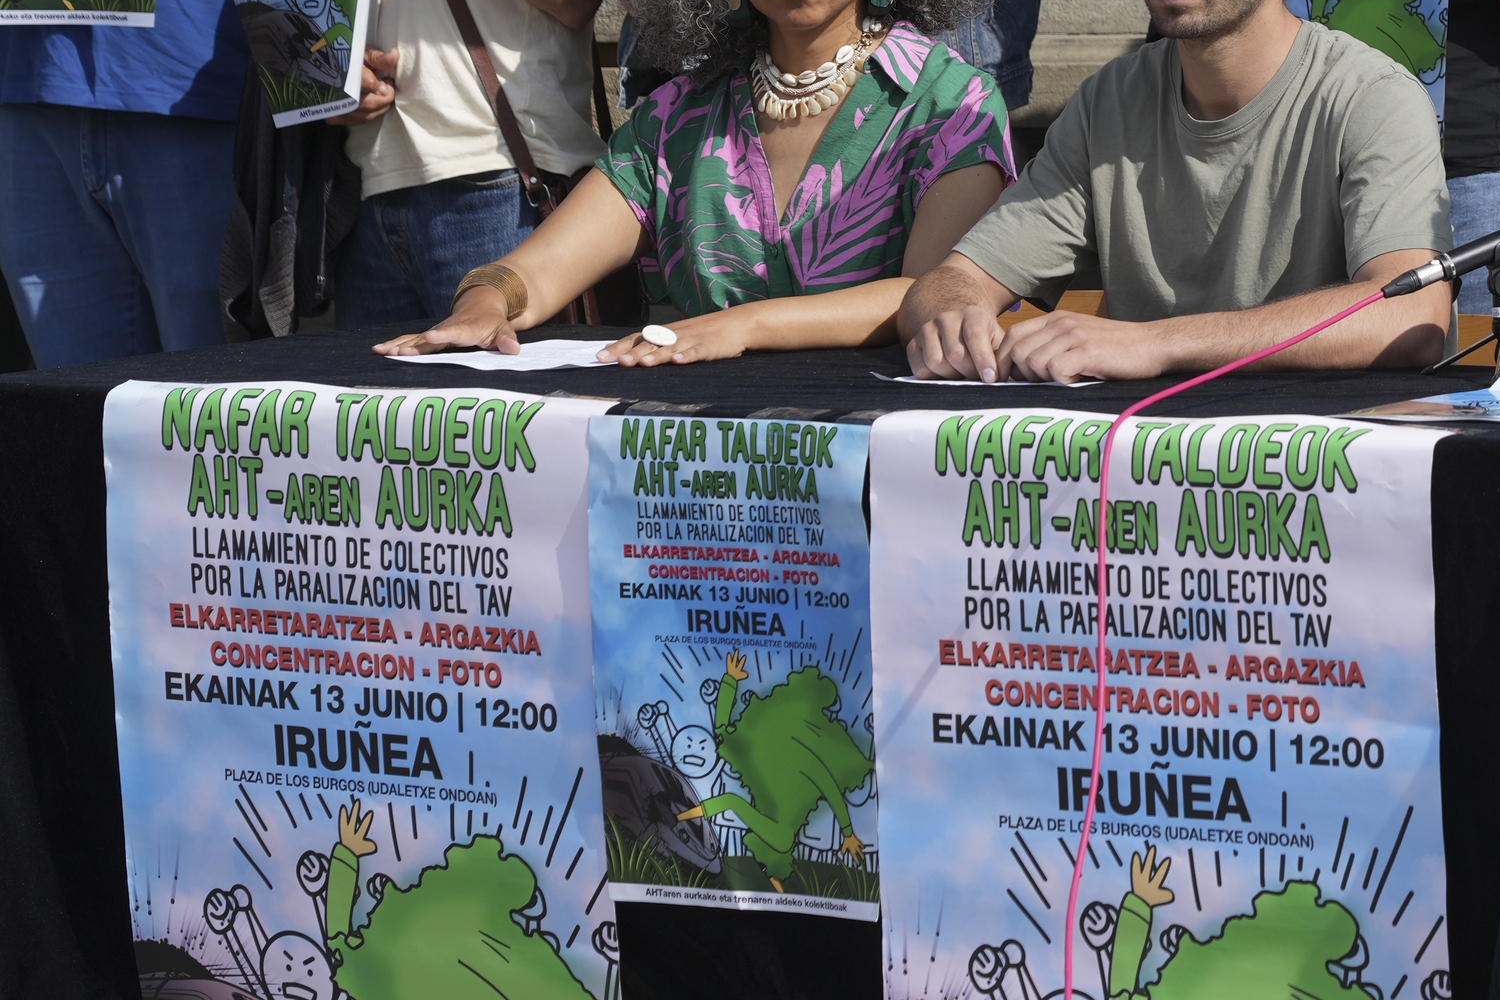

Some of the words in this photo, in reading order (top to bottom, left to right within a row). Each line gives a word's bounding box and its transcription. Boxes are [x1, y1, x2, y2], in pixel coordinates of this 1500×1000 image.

[161, 386, 316, 458] NAFAR
[336, 391, 546, 473] TALDEOK
[621, 417, 707, 462] NAFAR
[715, 420, 832, 469] TALDEOK
[935, 414, 1112, 481] NAFAR
[1130, 421, 1372, 492] TALDEOK
[374, 464, 511, 538] AURKA
[744, 464, 822, 503] AURKA
[1173, 487, 1330, 564] AURKA
[192, 527, 337, 568] LLAMAMIENTO
[346, 538, 369, 570] DE
[378, 540, 509, 580] COLECTIVOS
[190, 563, 232, 597] POR
[240, 567, 267, 599] LA
[276, 569, 421, 611] PARALIZACION
[430, 579, 468, 614] DEL
[477, 583, 514, 617] TAV
[621, 582, 703, 601] EKAINAK
[709, 585, 731, 602] 13
[735, 586, 789, 605] JUNIO
[803, 590, 850, 610] 12:00
[170, 603, 396, 645] ELKARRETARATZEA
[417, 622, 542, 656] ARGAZKIA
[686, 604, 787, 637] IRUÑEA
[209, 641, 414, 682] CONCENTRACION
[436, 658, 502, 688] FOTO
[167, 671, 300, 710] EKAINAK
[311, 683, 347, 714] 13
[355, 687, 448, 723] JUNIO
[474, 697, 561, 732] 12:00
[272, 719, 443, 780] IRUÑEA
[934, 712, 1087, 751] EKAINAK
[1100, 722, 1142, 754] 13
[1151, 725, 1258, 762] JUNIO
[1288, 733, 1388, 769] 12:00
[224, 769, 262, 785] PLAZA
[264, 772, 281, 786] DE
[283, 773, 310, 788] LOS
[312, 776, 365, 794] BURGOS
[647, 888, 681, 899] AHTaren
[683, 891, 717, 902] aurkako
[719, 894, 734, 903] eta
[735, 895, 772, 906] trenaren
[773, 896, 803, 908] aldeko
[803, 898, 848, 913] kolektiboak
